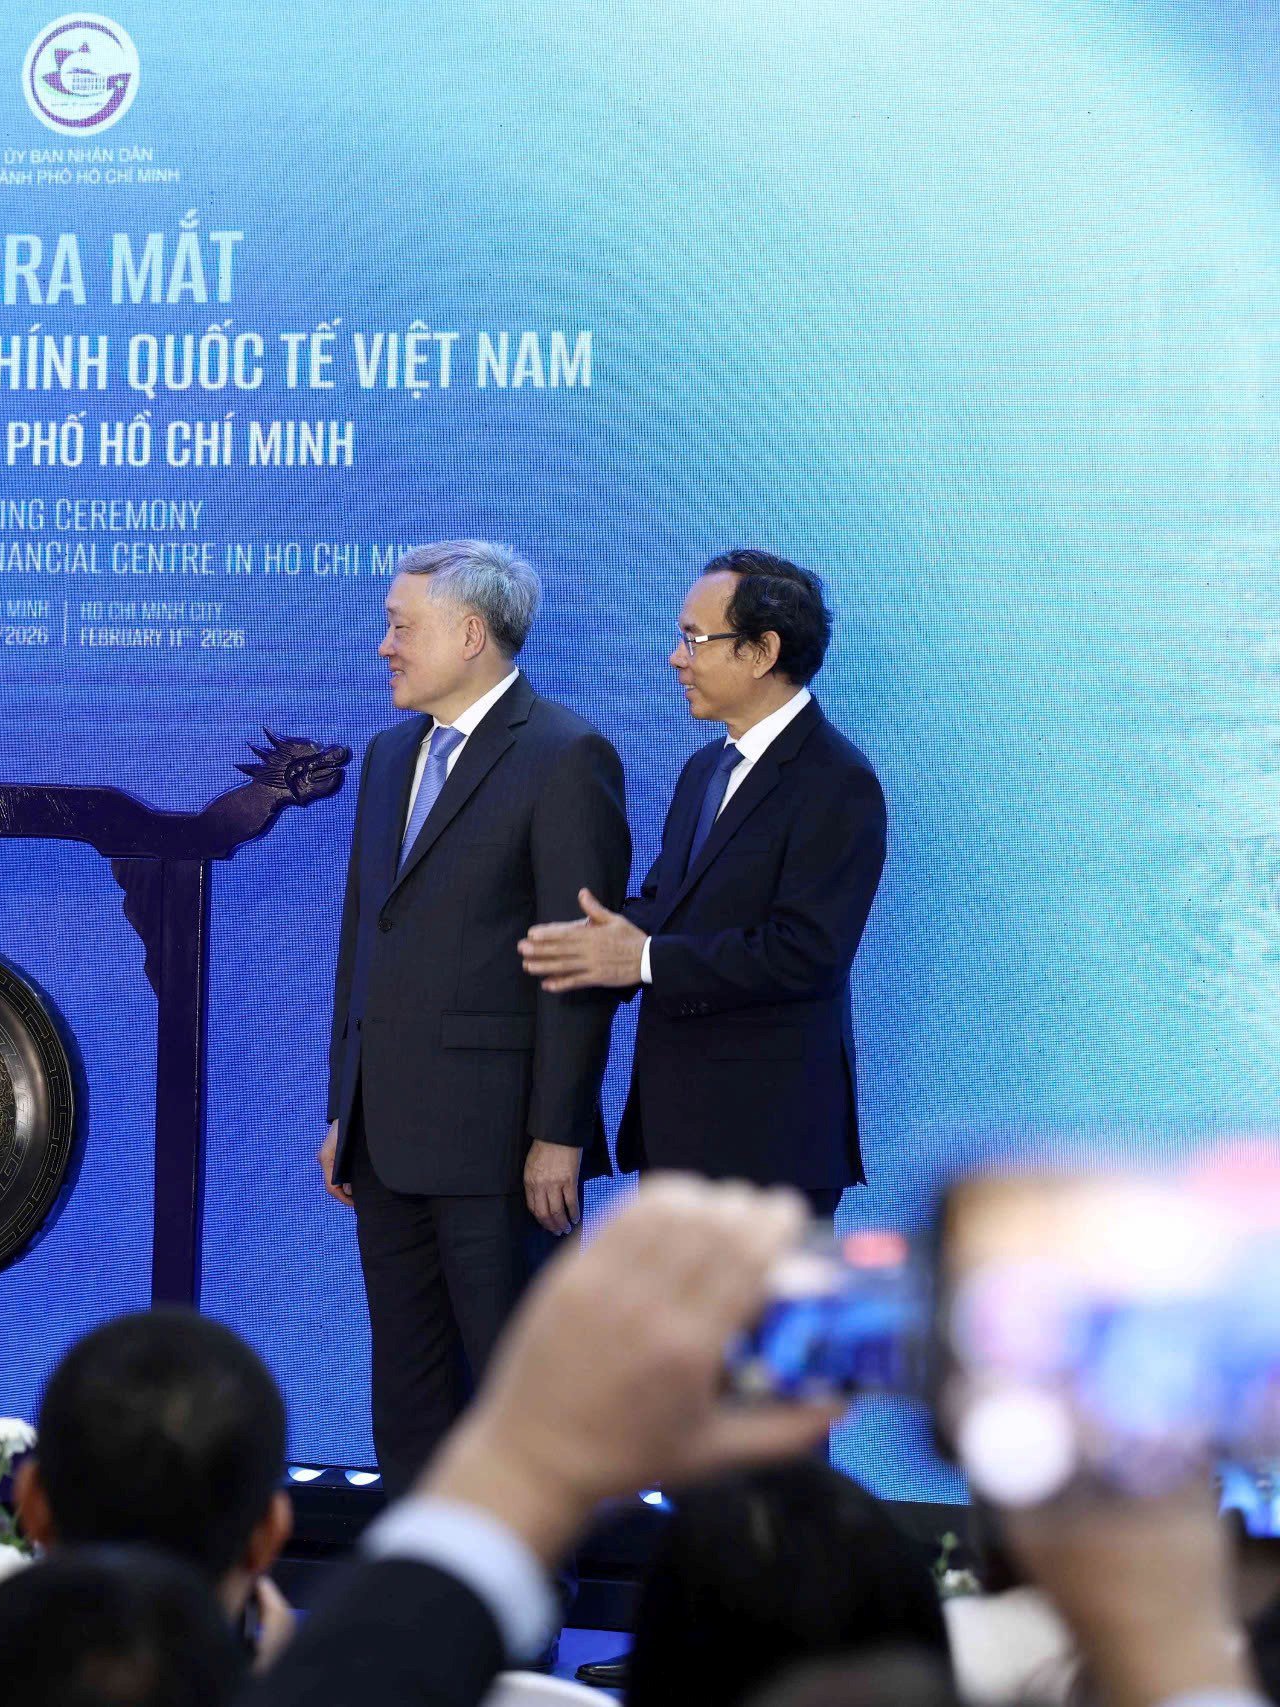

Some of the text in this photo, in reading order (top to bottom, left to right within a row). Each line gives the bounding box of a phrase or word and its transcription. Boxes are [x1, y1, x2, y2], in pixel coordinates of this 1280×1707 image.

[4, 233, 87, 305] RA
[112, 208, 244, 305] MẮT
[127, 319, 264, 400] QUỐC
[281, 317, 342, 389] TẾ
[353, 319, 459, 399] VIỆT
[477, 331, 593, 389] NAM
[7, 411, 87, 467] PHỐ
[100, 410, 152, 467] HỒ
[166, 412, 235, 467] CHÍ
[249, 421, 354, 467] MINH
[55, 498, 203, 532] CEREMONY
[113, 542, 216, 575] CENTRE
[226, 543, 252, 576] IN
[265, 543, 301, 576] HO
[313, 542, 359, 576] CHI
[142, 601, 185, 620] MINH
[80, 626, 162, 647] FEBRUARY
[201, 628, 246, 648] 2026
